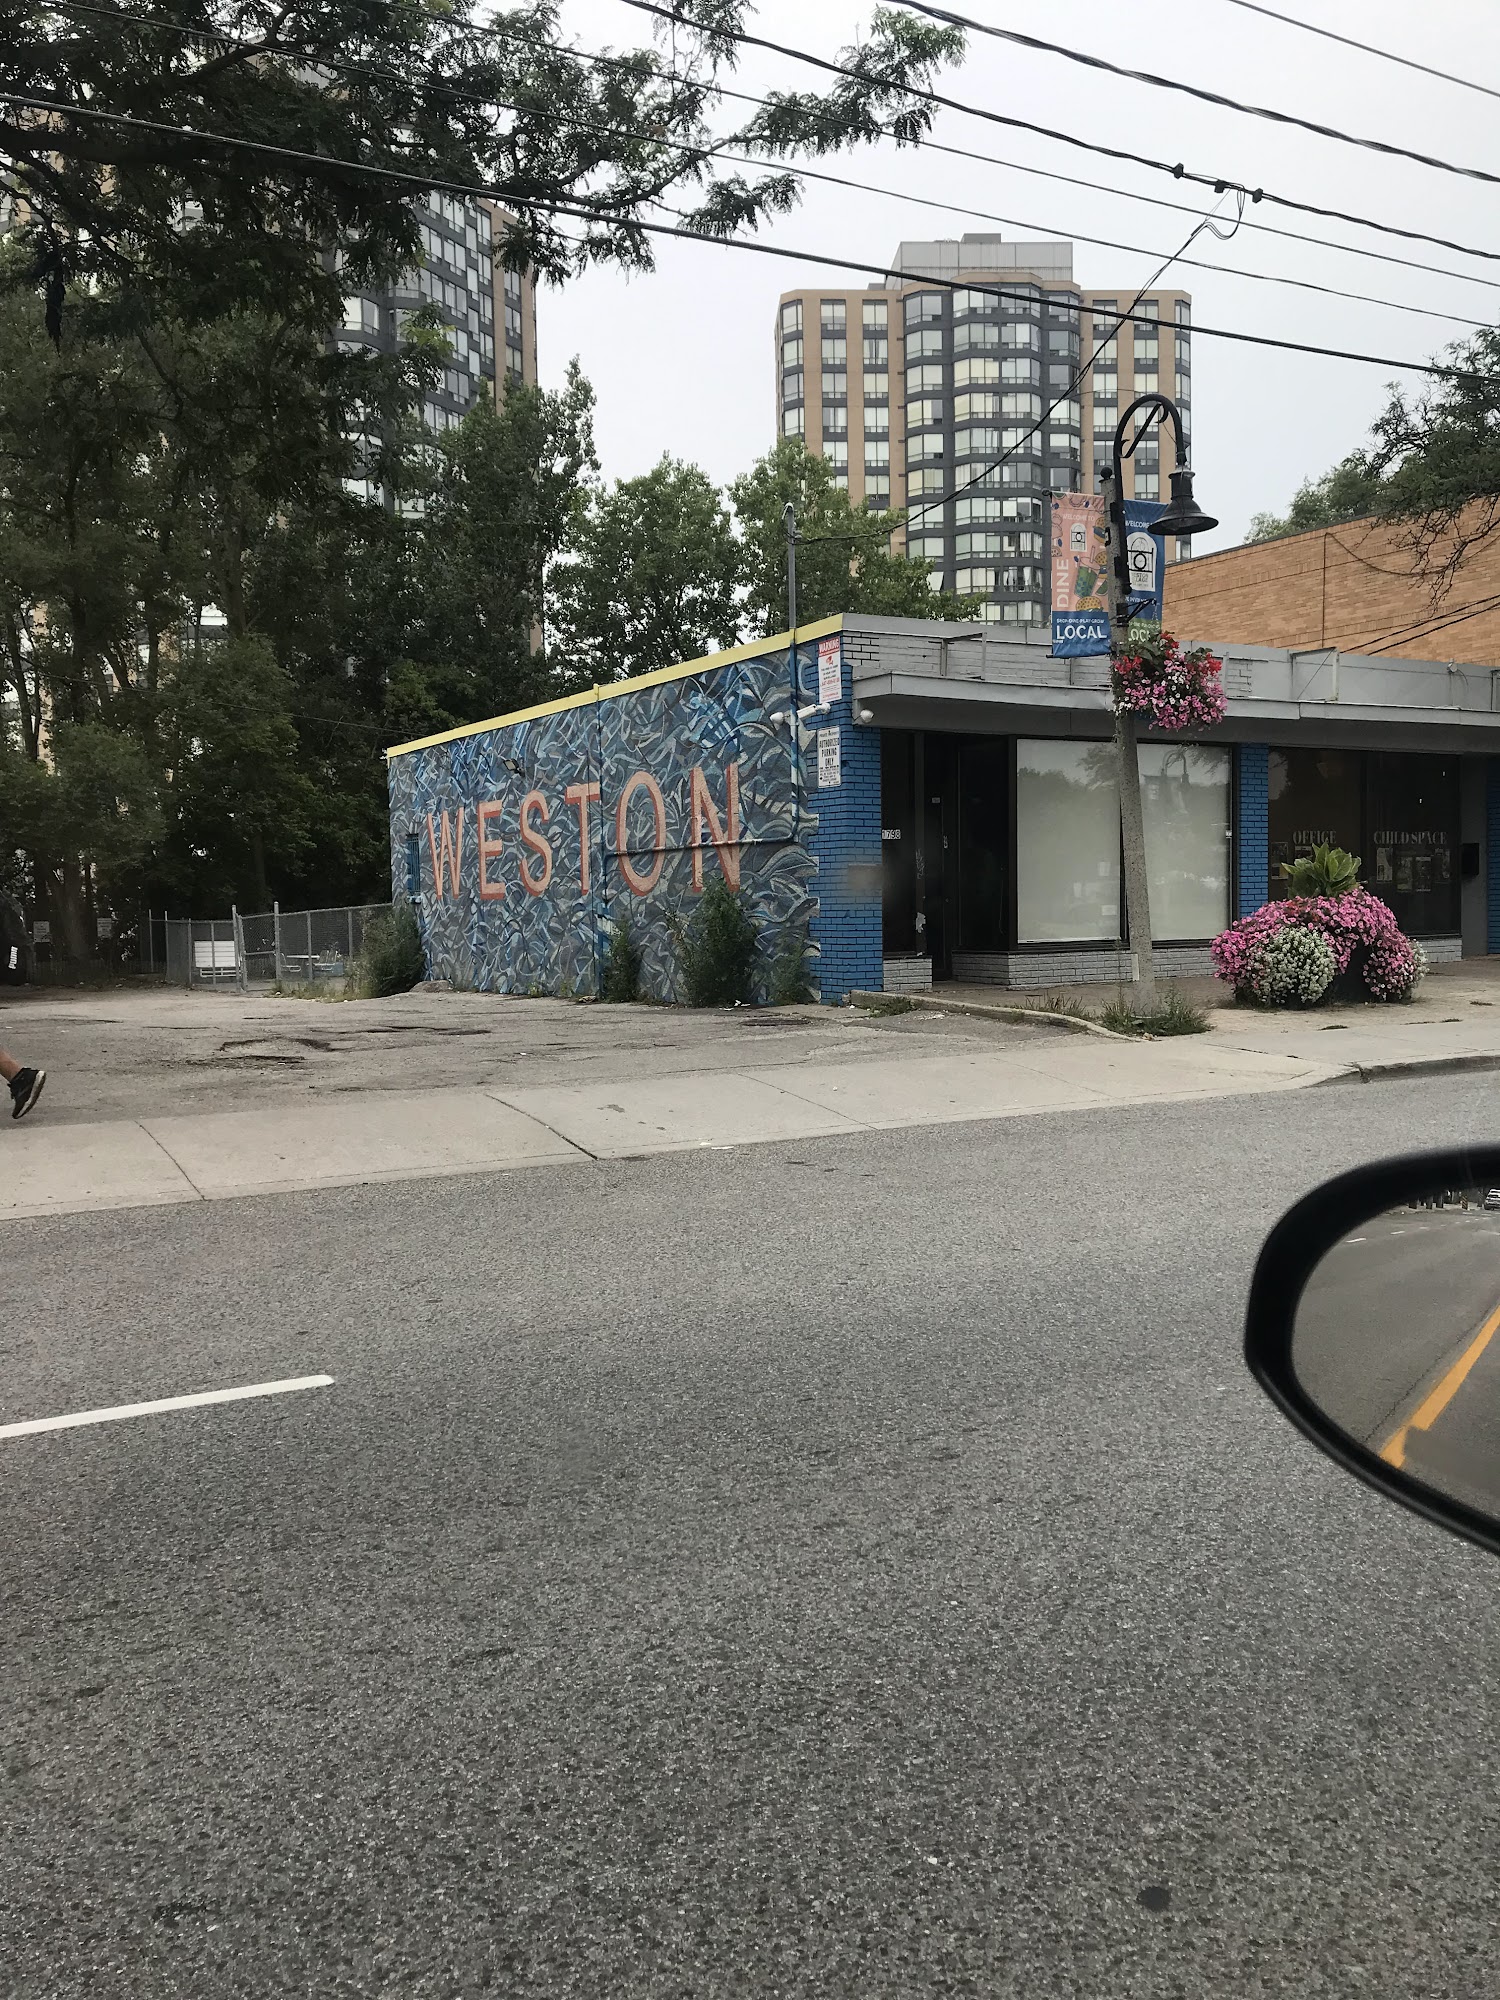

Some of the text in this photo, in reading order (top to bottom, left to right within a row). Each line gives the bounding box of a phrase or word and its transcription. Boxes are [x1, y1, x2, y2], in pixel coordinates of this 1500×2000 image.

[1056, 559, 1069, 608] DINE
[1056, 624, 1108, 640] LOCAL
[819, 638, 840, 653] WARNING
[821, 747, 837, 758] PARKING
[825, 757, 834, 767] ONLY
[427, 762, 741, 900] WESTON
[1292, 830, 1337, 845] OFFICE
[1373, 831, 1447, 845] CHILD SPACE
